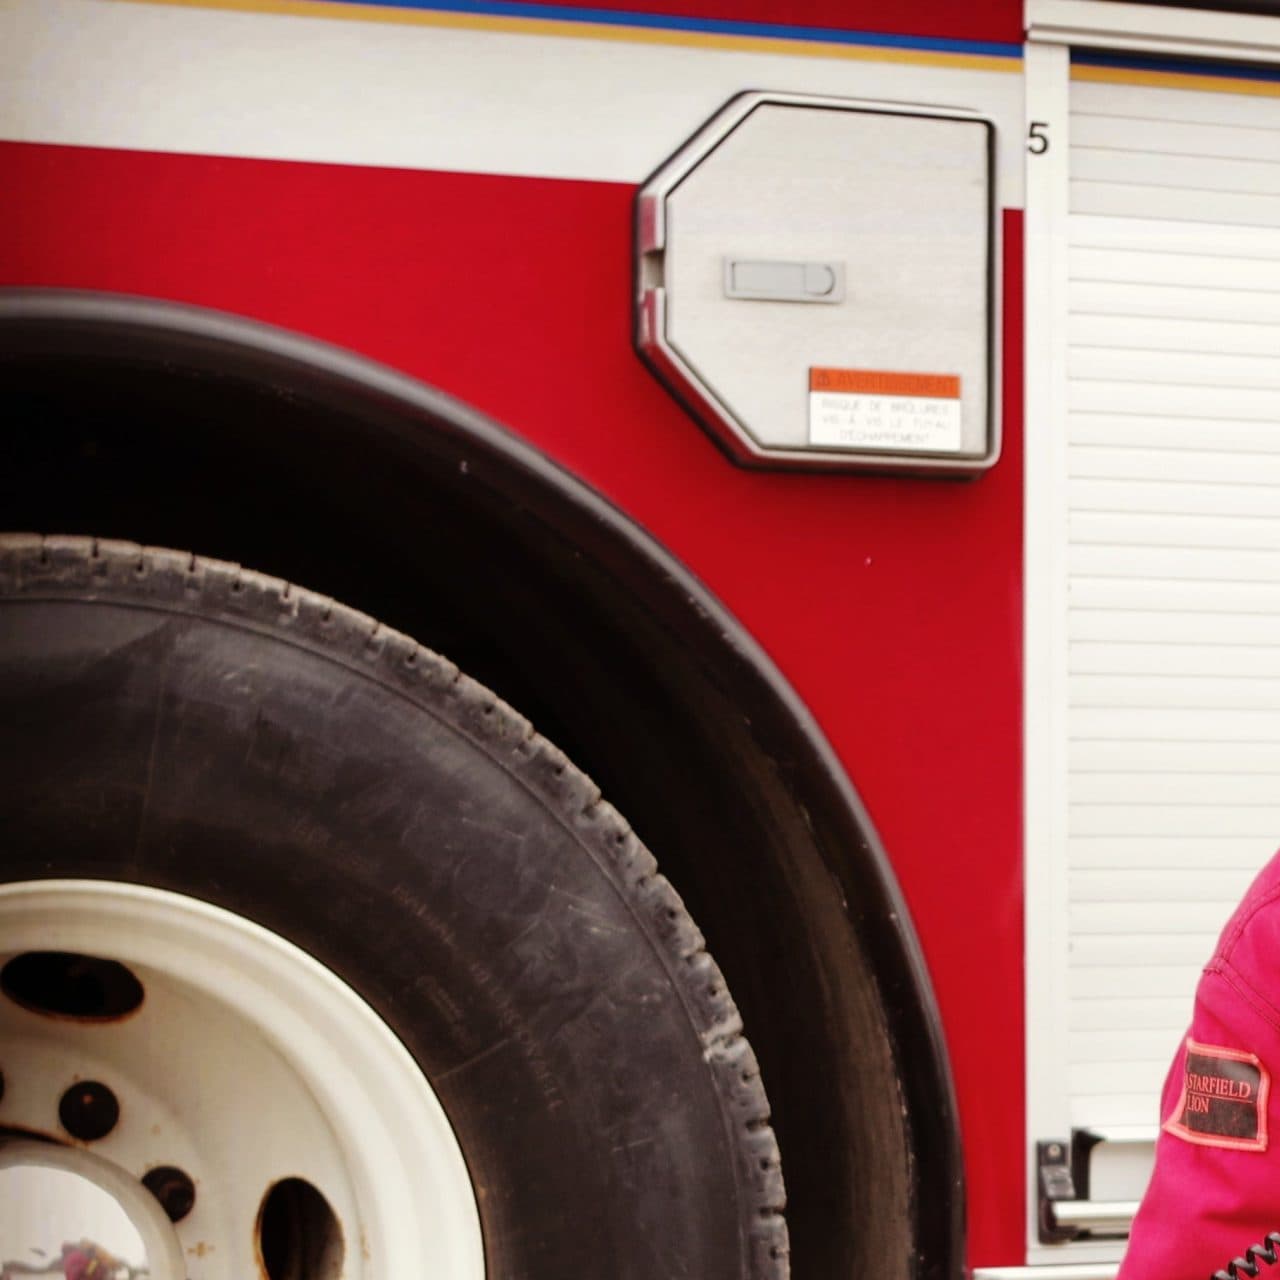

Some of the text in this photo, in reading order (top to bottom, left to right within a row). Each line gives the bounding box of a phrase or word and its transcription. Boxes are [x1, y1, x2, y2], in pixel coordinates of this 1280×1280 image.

[1028, 122, 1048, 154] 5
[1186, 1073, 1252, 1098] STARFIELD
[1186, 1094, 1209, 1112] LION
